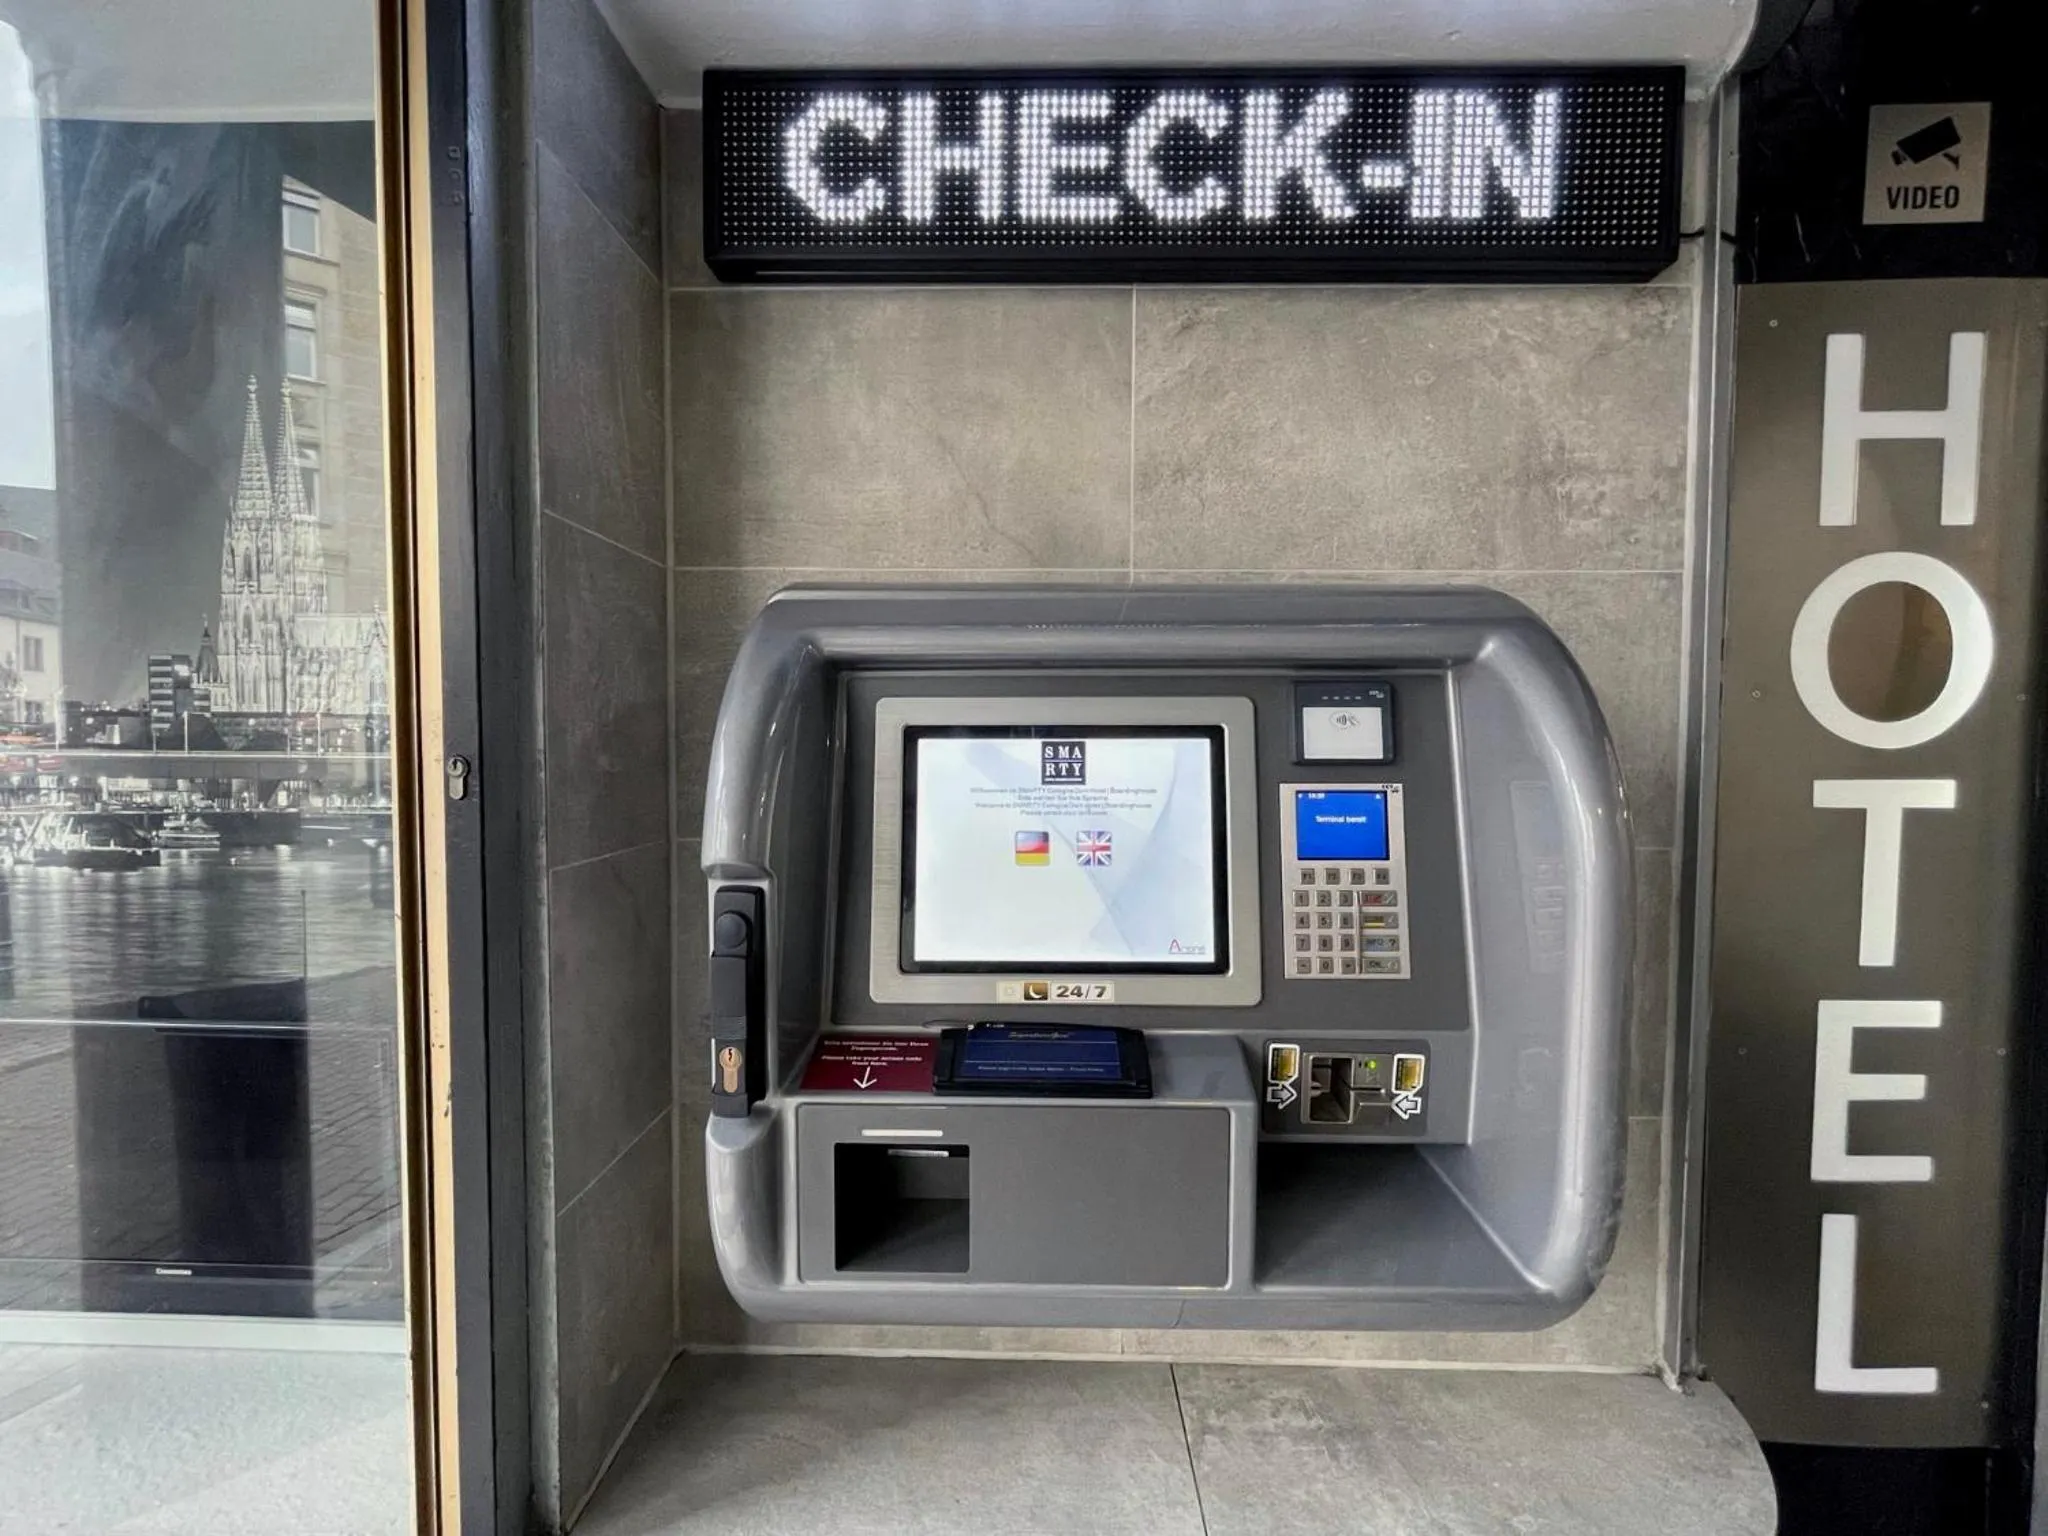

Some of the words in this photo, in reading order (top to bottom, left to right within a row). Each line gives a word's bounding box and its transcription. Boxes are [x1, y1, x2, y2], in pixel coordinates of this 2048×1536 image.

[782, 89, 1563, 224] CHECK-IN
[1887, 184, 1961, 211] VIDEO
[1789, 330, 1994, 1395] HOTEL
[1056, 984, 1107, 1000] 24/7
